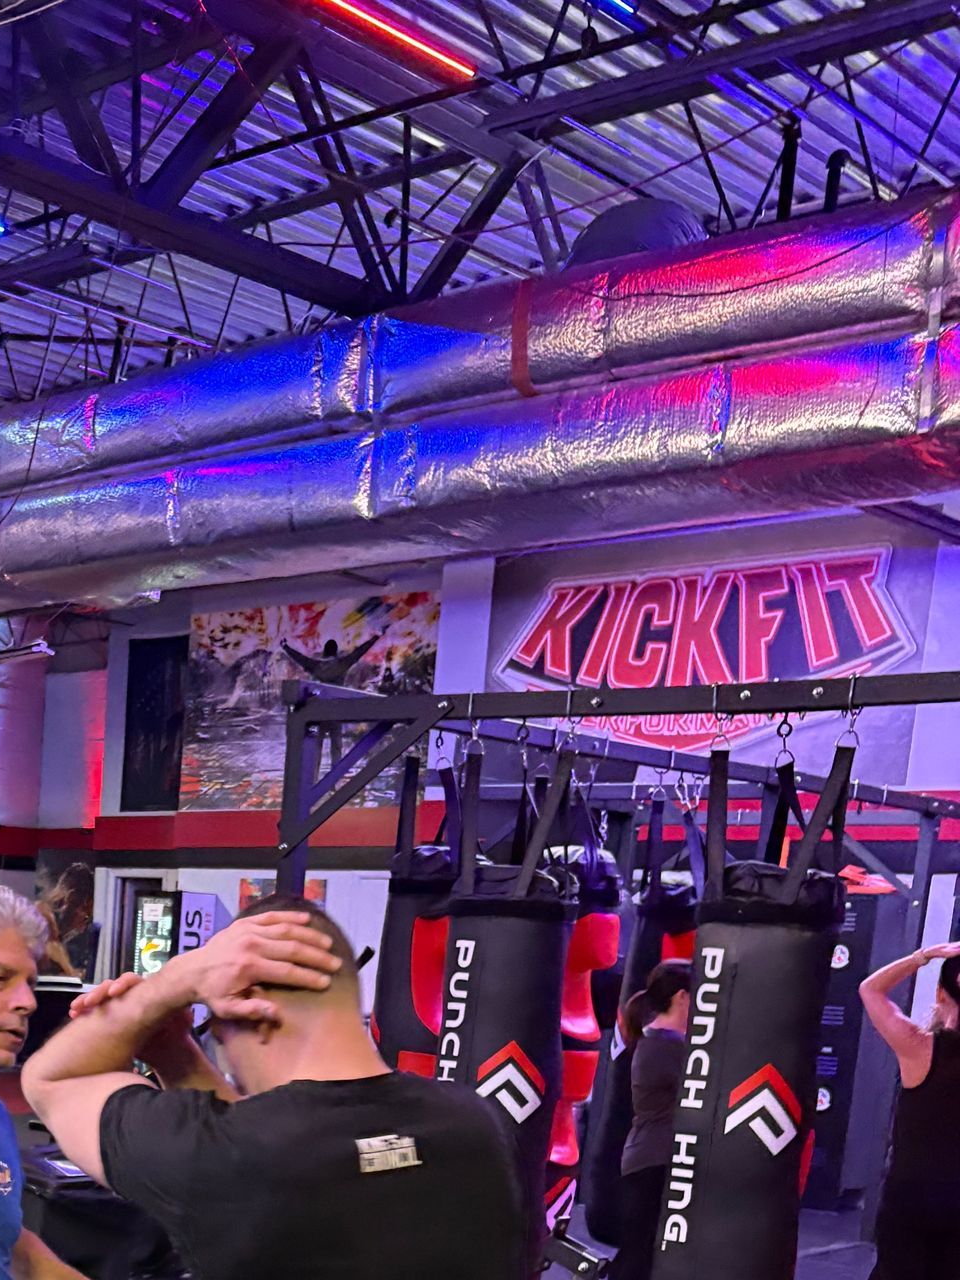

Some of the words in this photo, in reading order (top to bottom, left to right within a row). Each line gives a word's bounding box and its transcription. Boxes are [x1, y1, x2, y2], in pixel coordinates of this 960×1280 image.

[515, 555, 894, 689] KICKFIT
[437, 939, 476, 1082] PUNCH
[680, 947, 725, 1109] PUNCH
[663, 1133, 698, 1243] KING
